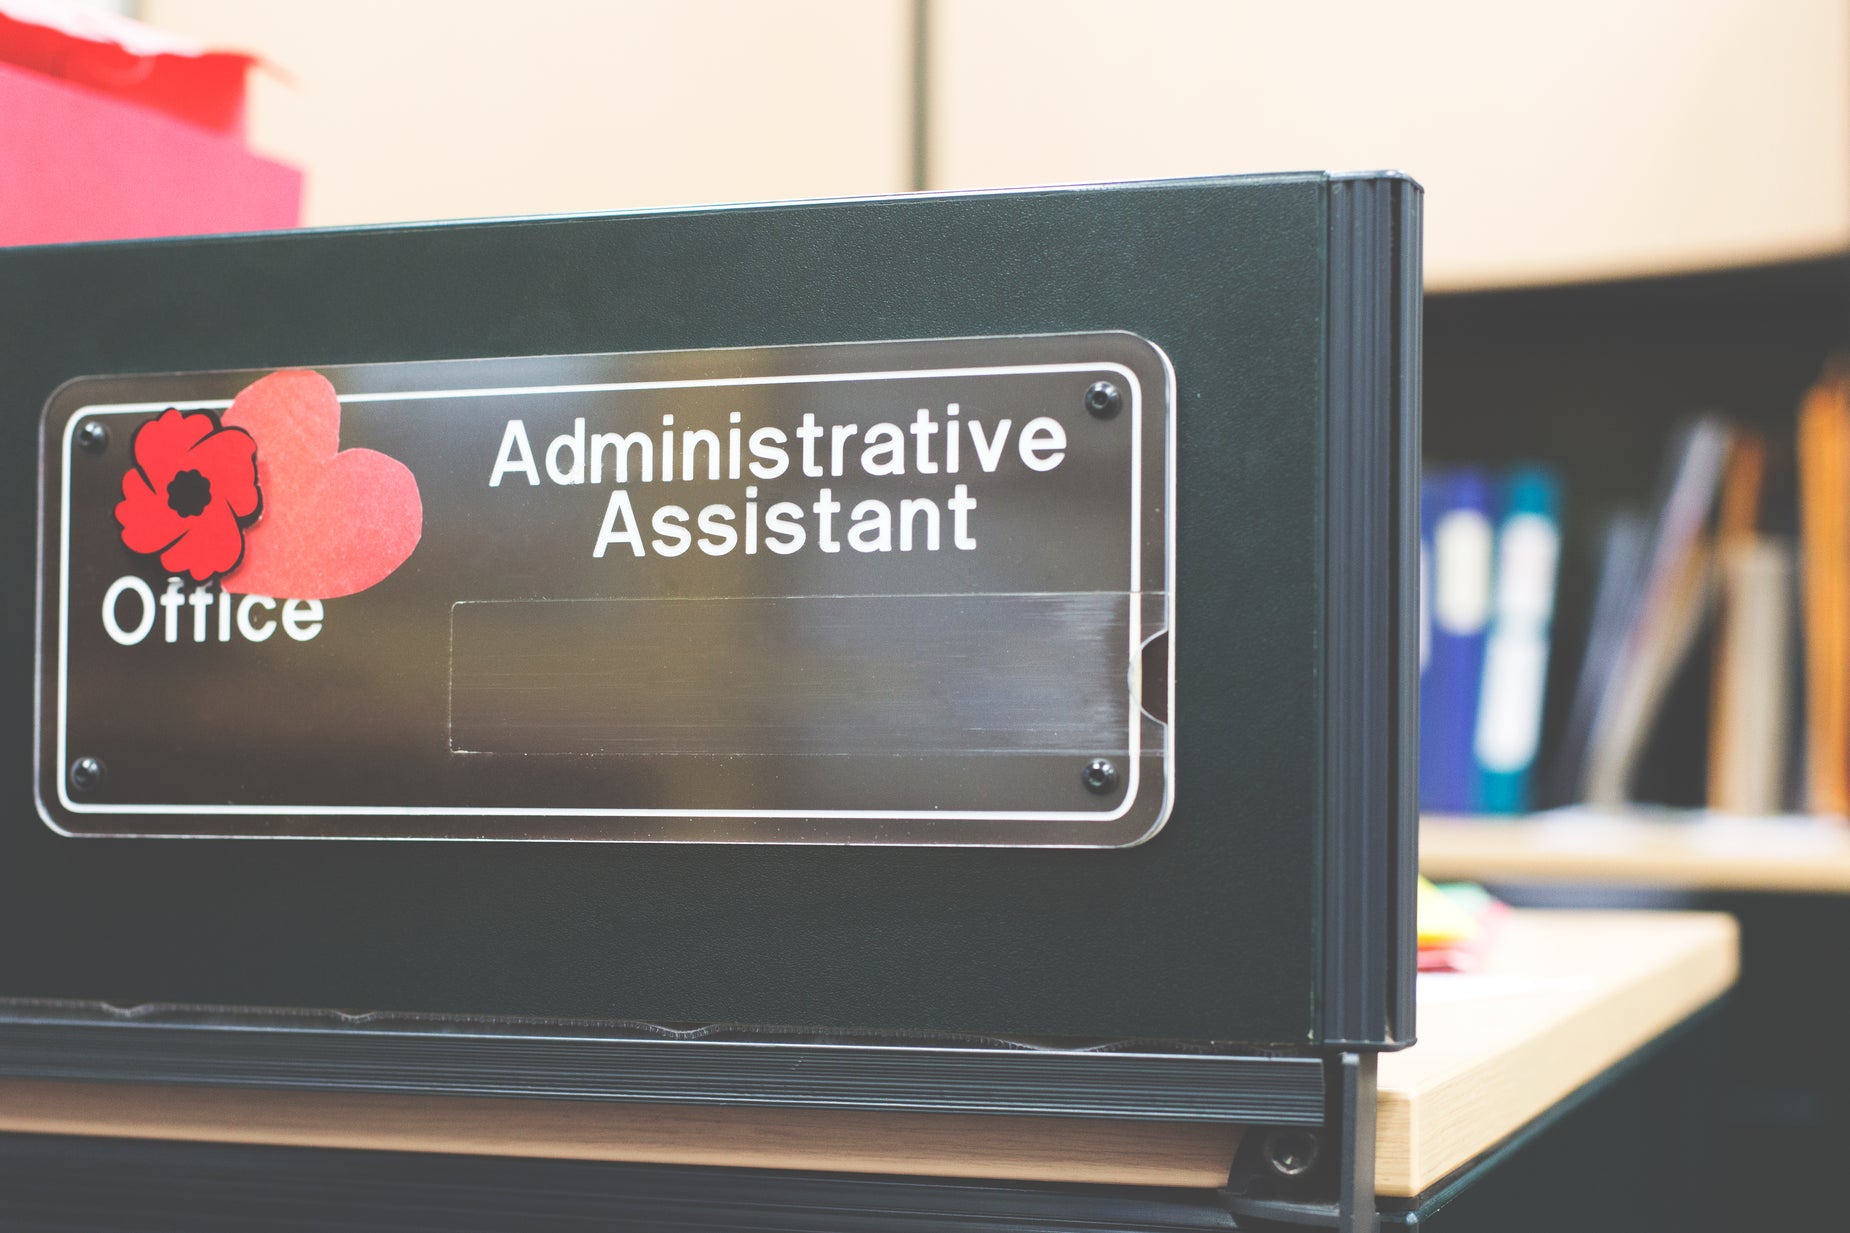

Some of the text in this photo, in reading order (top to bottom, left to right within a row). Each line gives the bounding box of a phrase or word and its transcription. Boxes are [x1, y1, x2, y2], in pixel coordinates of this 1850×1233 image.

[487, 402, 1068, 488] Administrative
[591, 483, 979, 559] Assistant
[101, 575, 325, 647] Office
